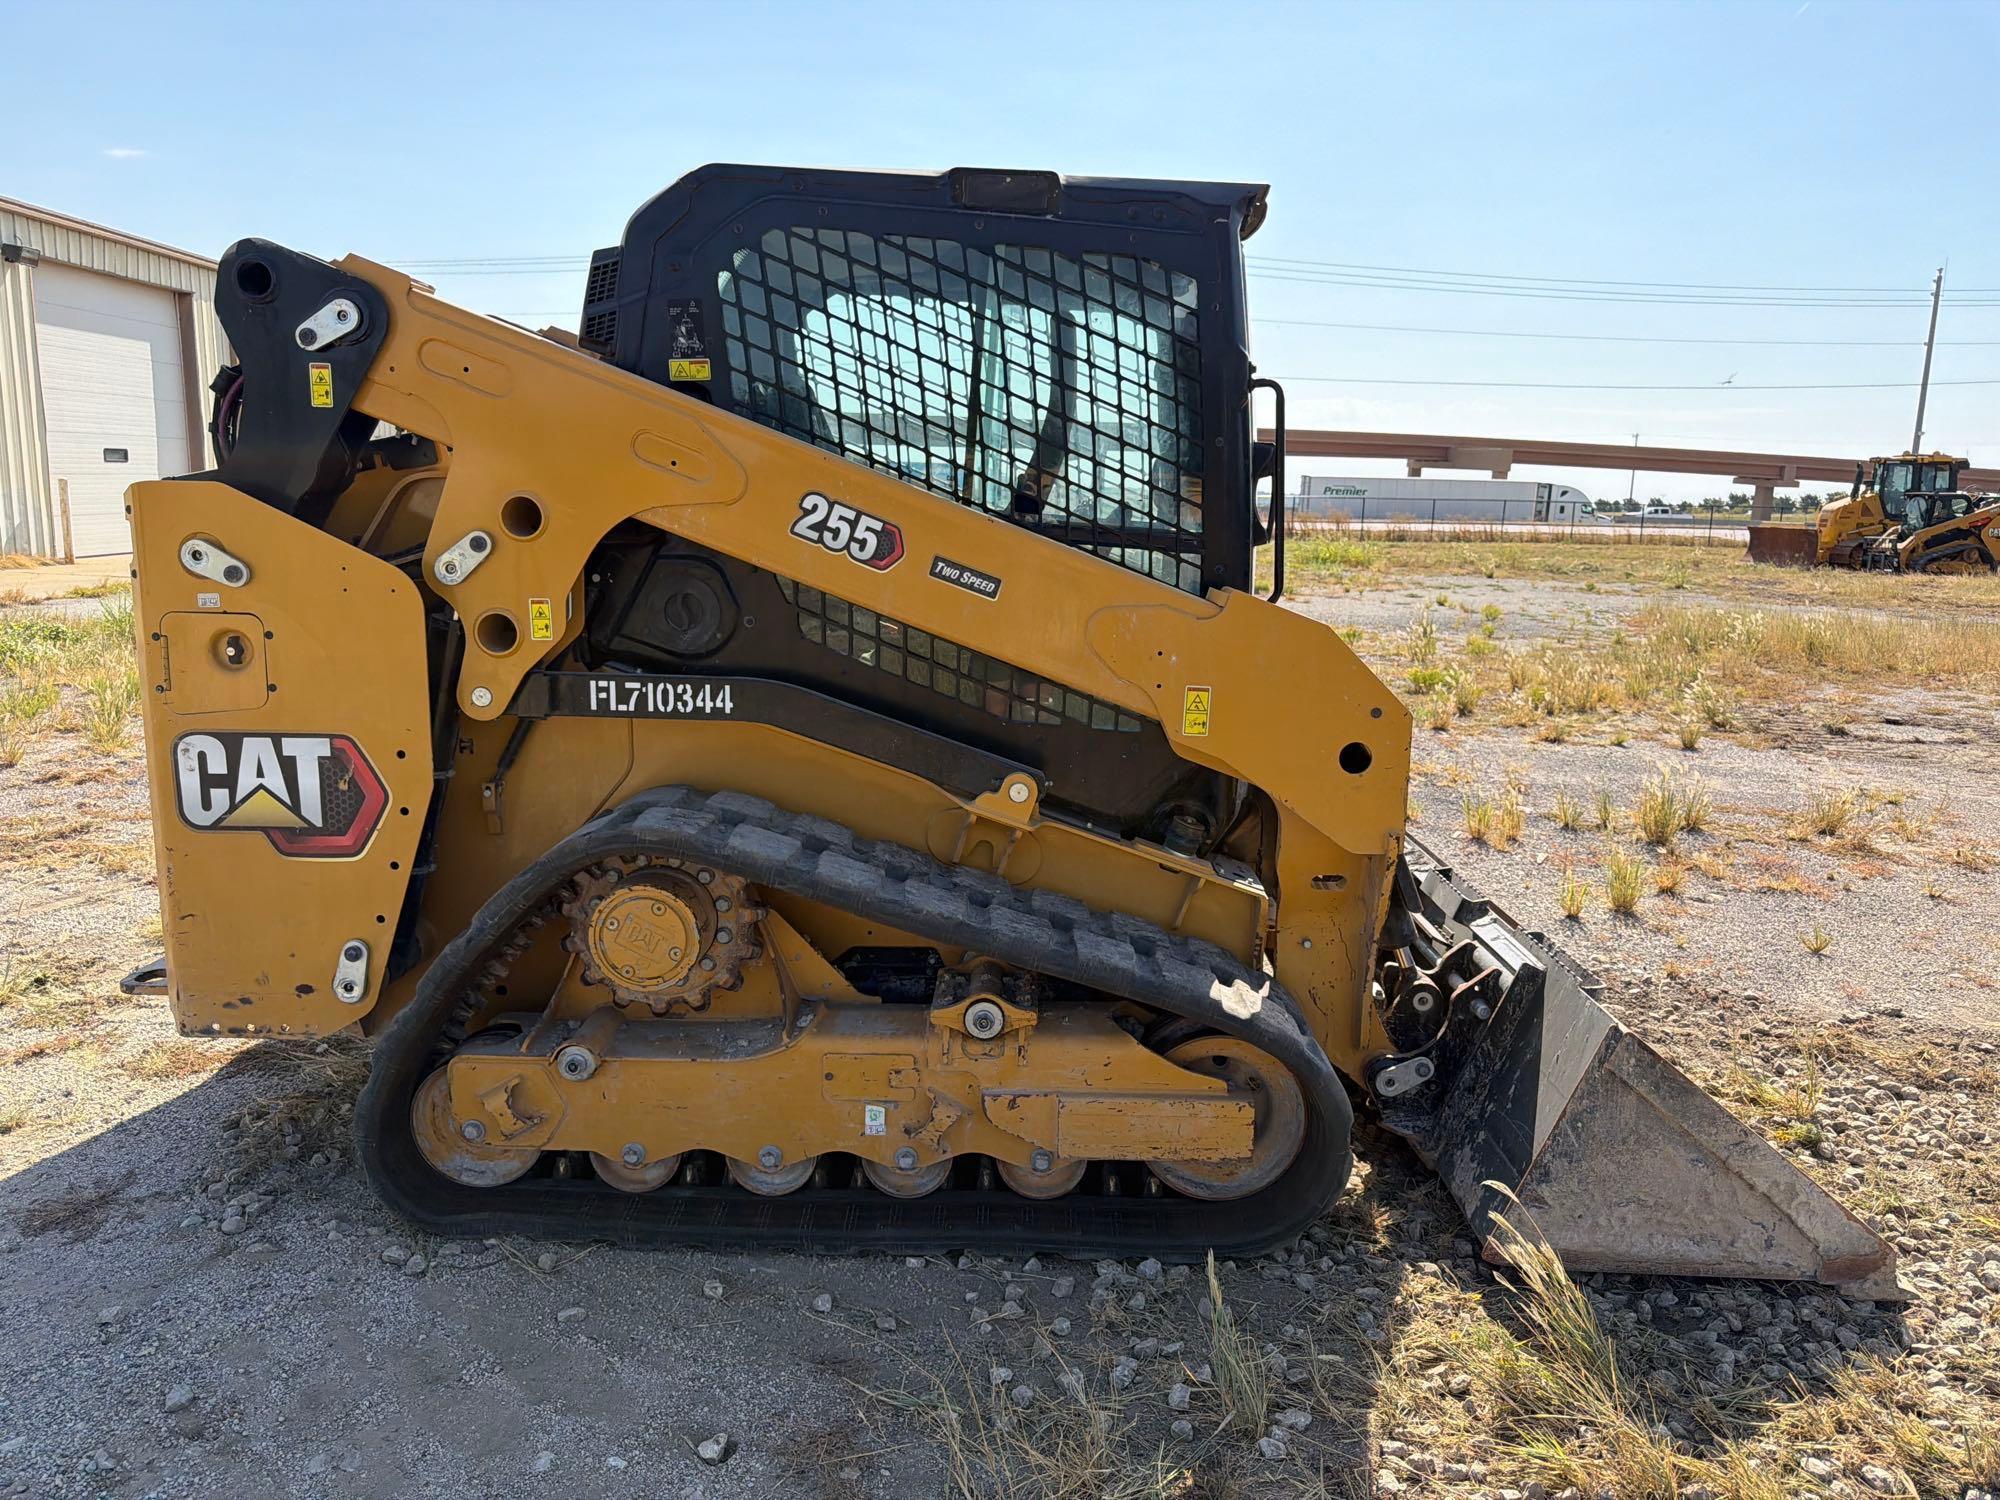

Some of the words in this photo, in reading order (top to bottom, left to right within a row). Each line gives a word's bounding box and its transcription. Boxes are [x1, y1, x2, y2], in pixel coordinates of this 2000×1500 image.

[1323, 486, 1368, 496] Premier
[793, 494, 884, 561] 255
[589, 680, 734, 714] FL710344
[177, 734, 331, 828] CAT
